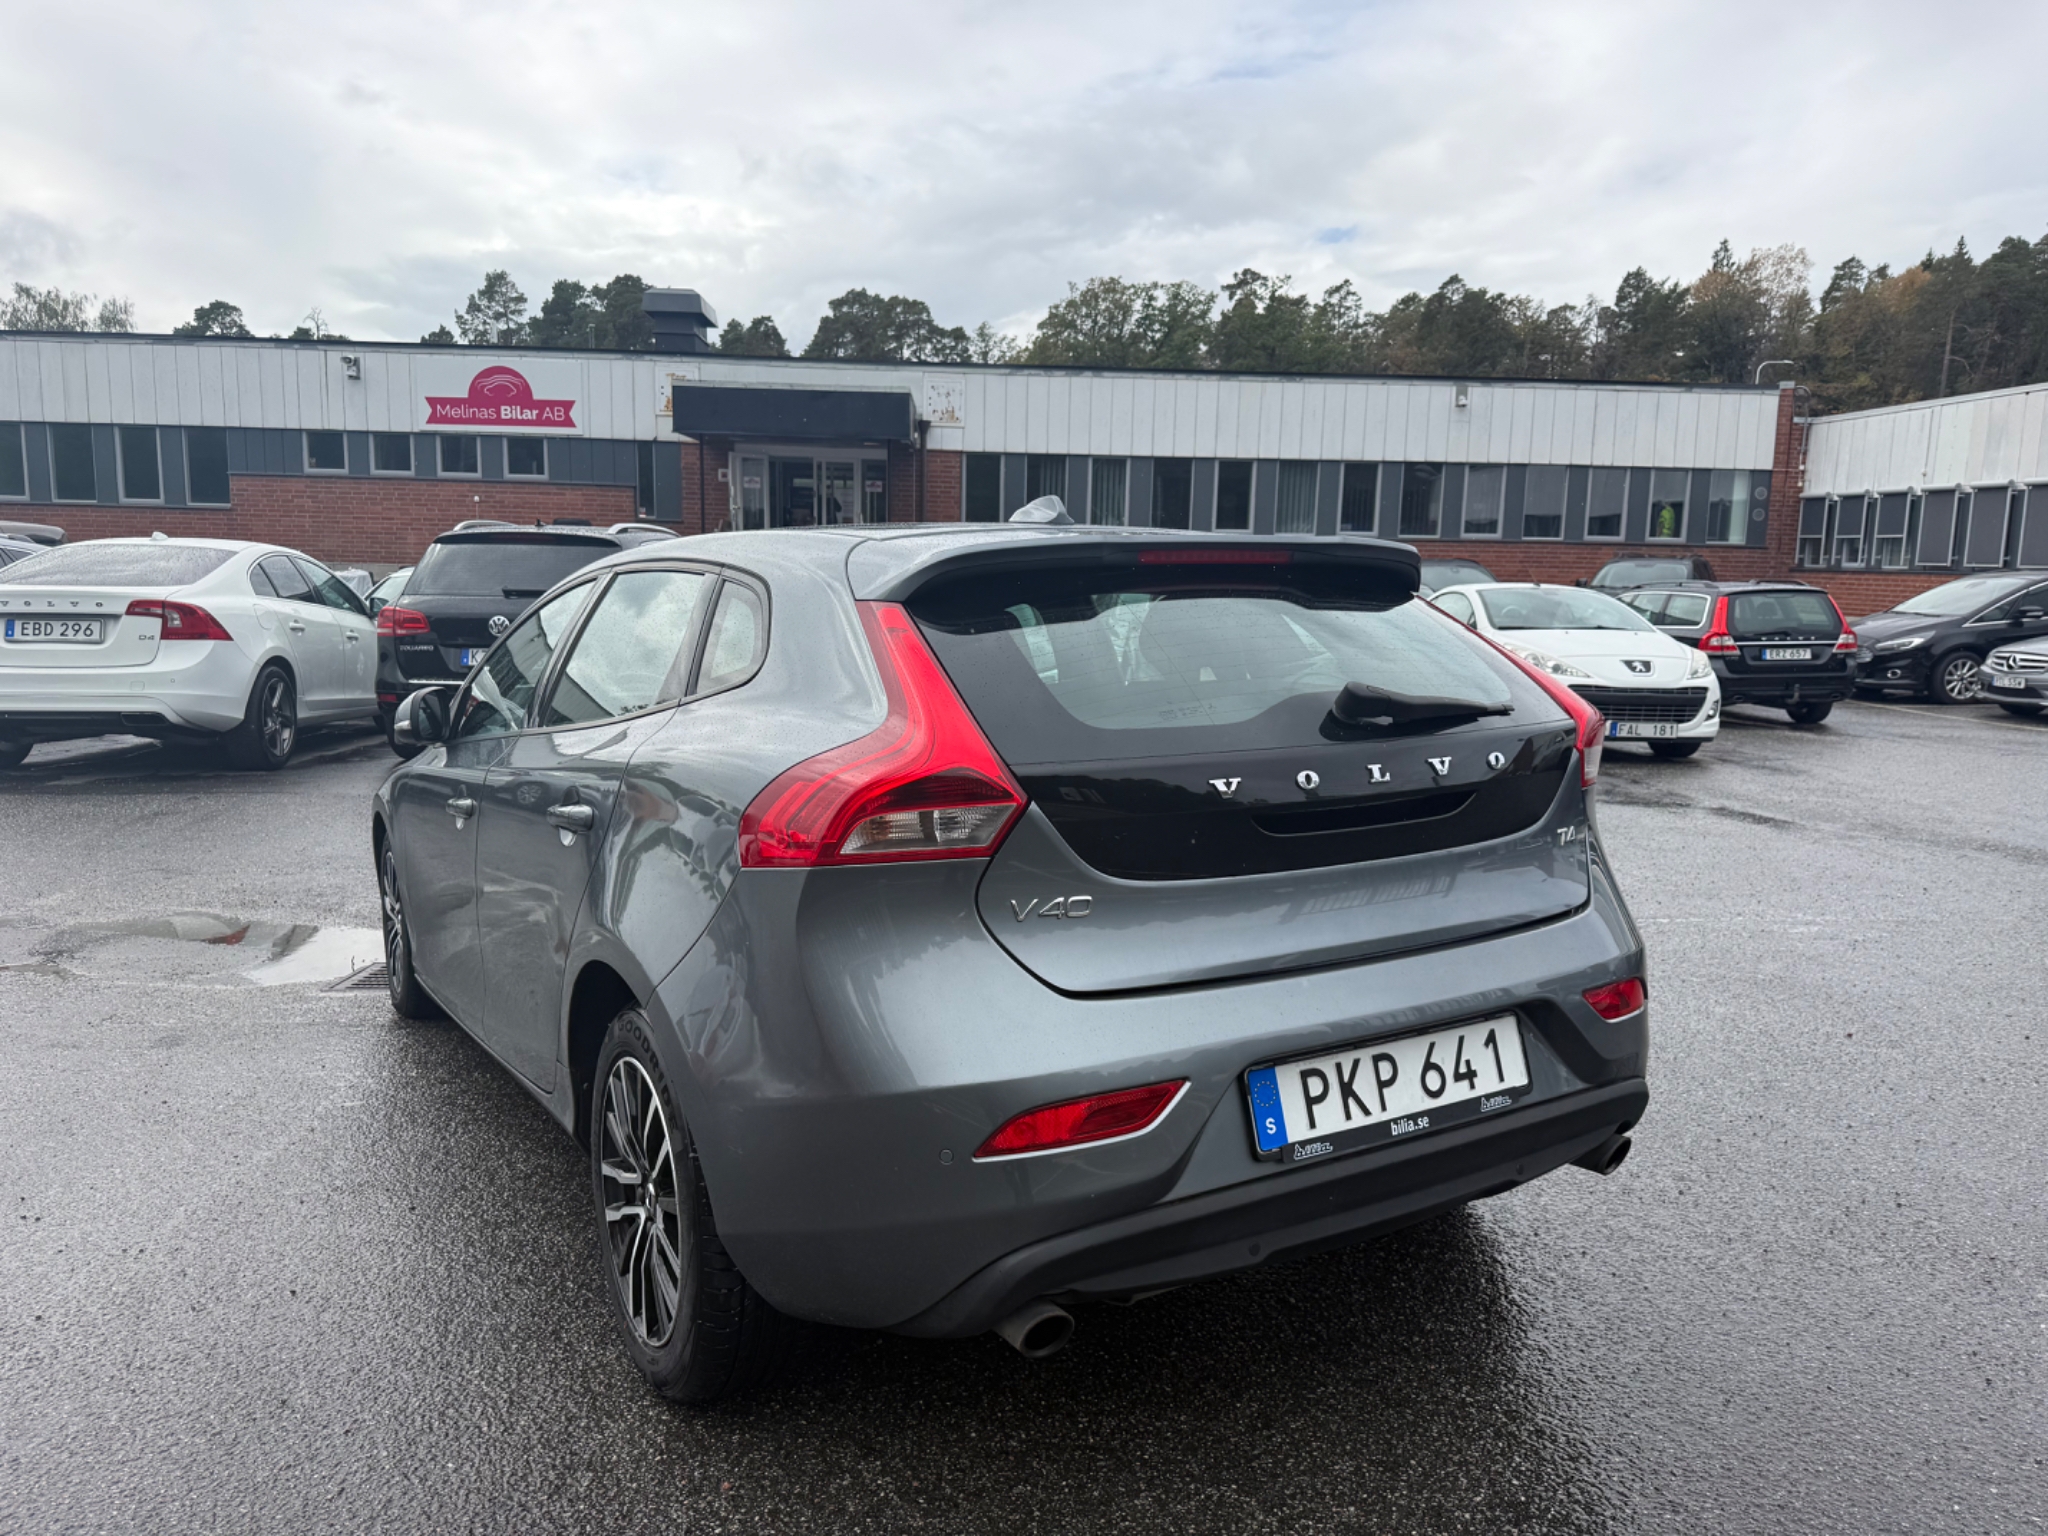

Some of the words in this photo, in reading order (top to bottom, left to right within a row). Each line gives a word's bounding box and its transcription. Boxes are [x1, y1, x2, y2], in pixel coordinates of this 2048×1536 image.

[436, 404, 497, 419] Melinas
[500, 405, 539, 420] Bilar
[542, 406, 566, 421] AB
[20, 622, 54, 637] EBD
[59, 622, 94, 638] 296
[1619, 723, 1641, 736] FAL
[1653, 724, 1675, 737] 181
[1208, 751, 1506, 799] VOLVO
[1010, 895, 1093, 922] V40
[1299, 1051, 1399, 1130] PKP
[1419, 1027, 1506, 1100] 641
[1264, 1117, 1278, 1136] S
[1390, 1115, 1430, 1137] bilia.se
